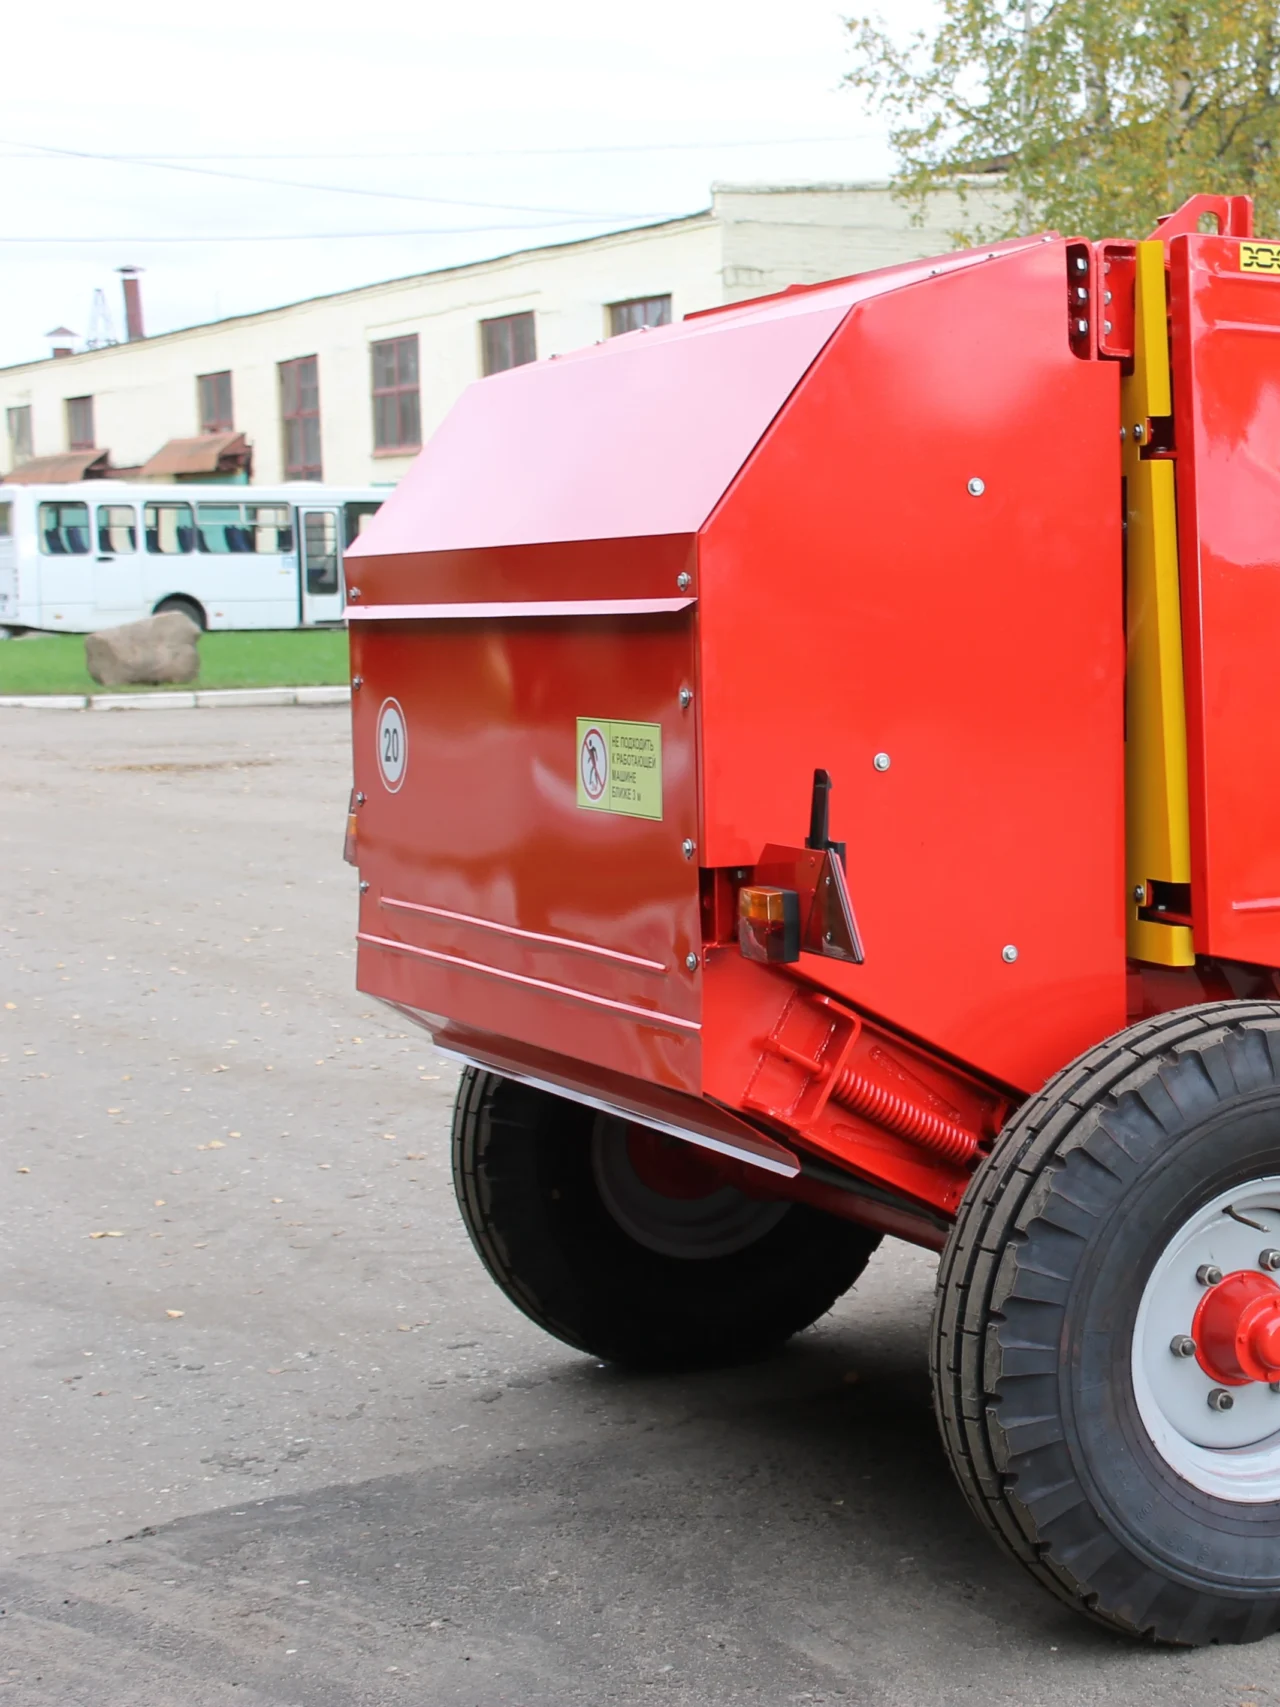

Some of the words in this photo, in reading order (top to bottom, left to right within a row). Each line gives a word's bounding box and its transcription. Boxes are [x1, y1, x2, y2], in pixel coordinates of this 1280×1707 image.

[384, 727, 399, 763] 20
[612, 736, 619, 748] НЕ
[620, 736, 654, 752] ПОДХОДИТЬ
[616, 753, 656, 769] РАБОТАЮЩЕЙ
[612, 769, 636, 784] МАШИНЕ
[612, 786, 631, 800] БЛИЖЕ
